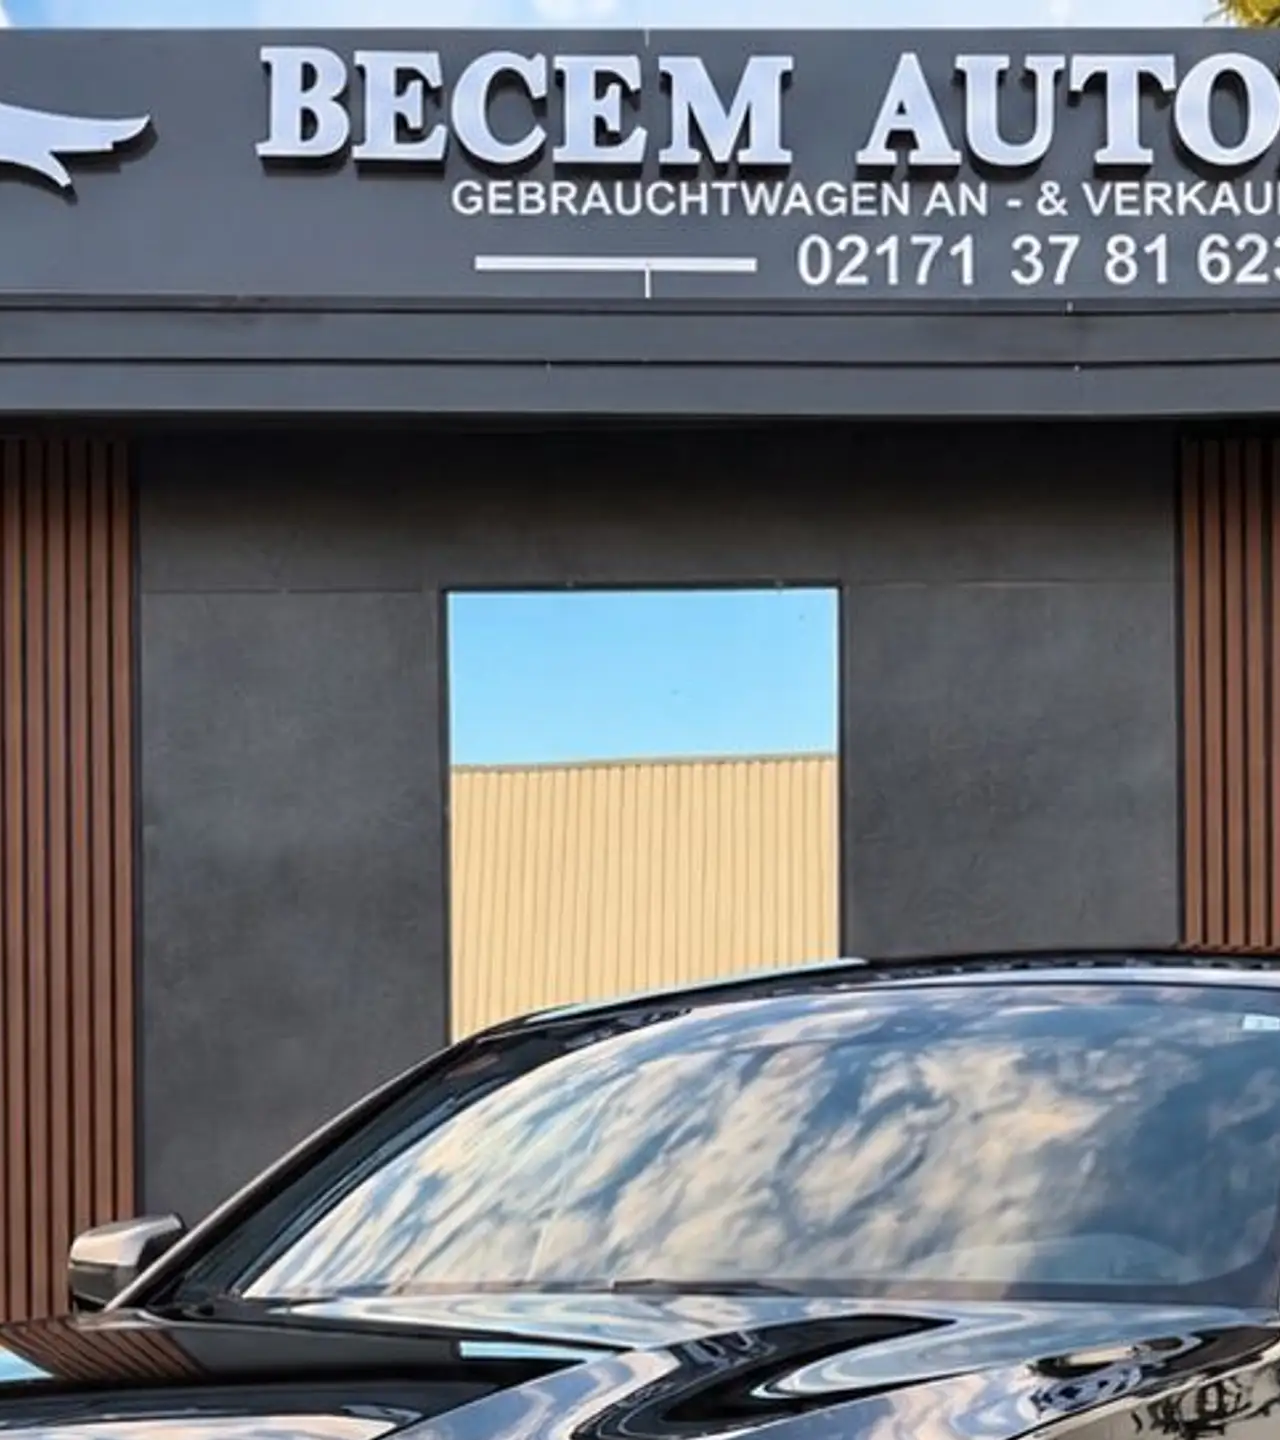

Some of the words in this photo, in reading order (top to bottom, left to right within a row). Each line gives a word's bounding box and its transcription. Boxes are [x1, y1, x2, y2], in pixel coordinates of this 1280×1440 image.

[255, 46, 794, 164] BECEM
[451, 179, 911, 217] GEBRAUCHTWAGEN
[923, 181, 988, 217] AN
[1035, 180, 1069, 217] &
[797, 233, 974, 287] 02171
[1010, 233, 1082, 286] 37
[1104, 232, 1169, 286] 81
